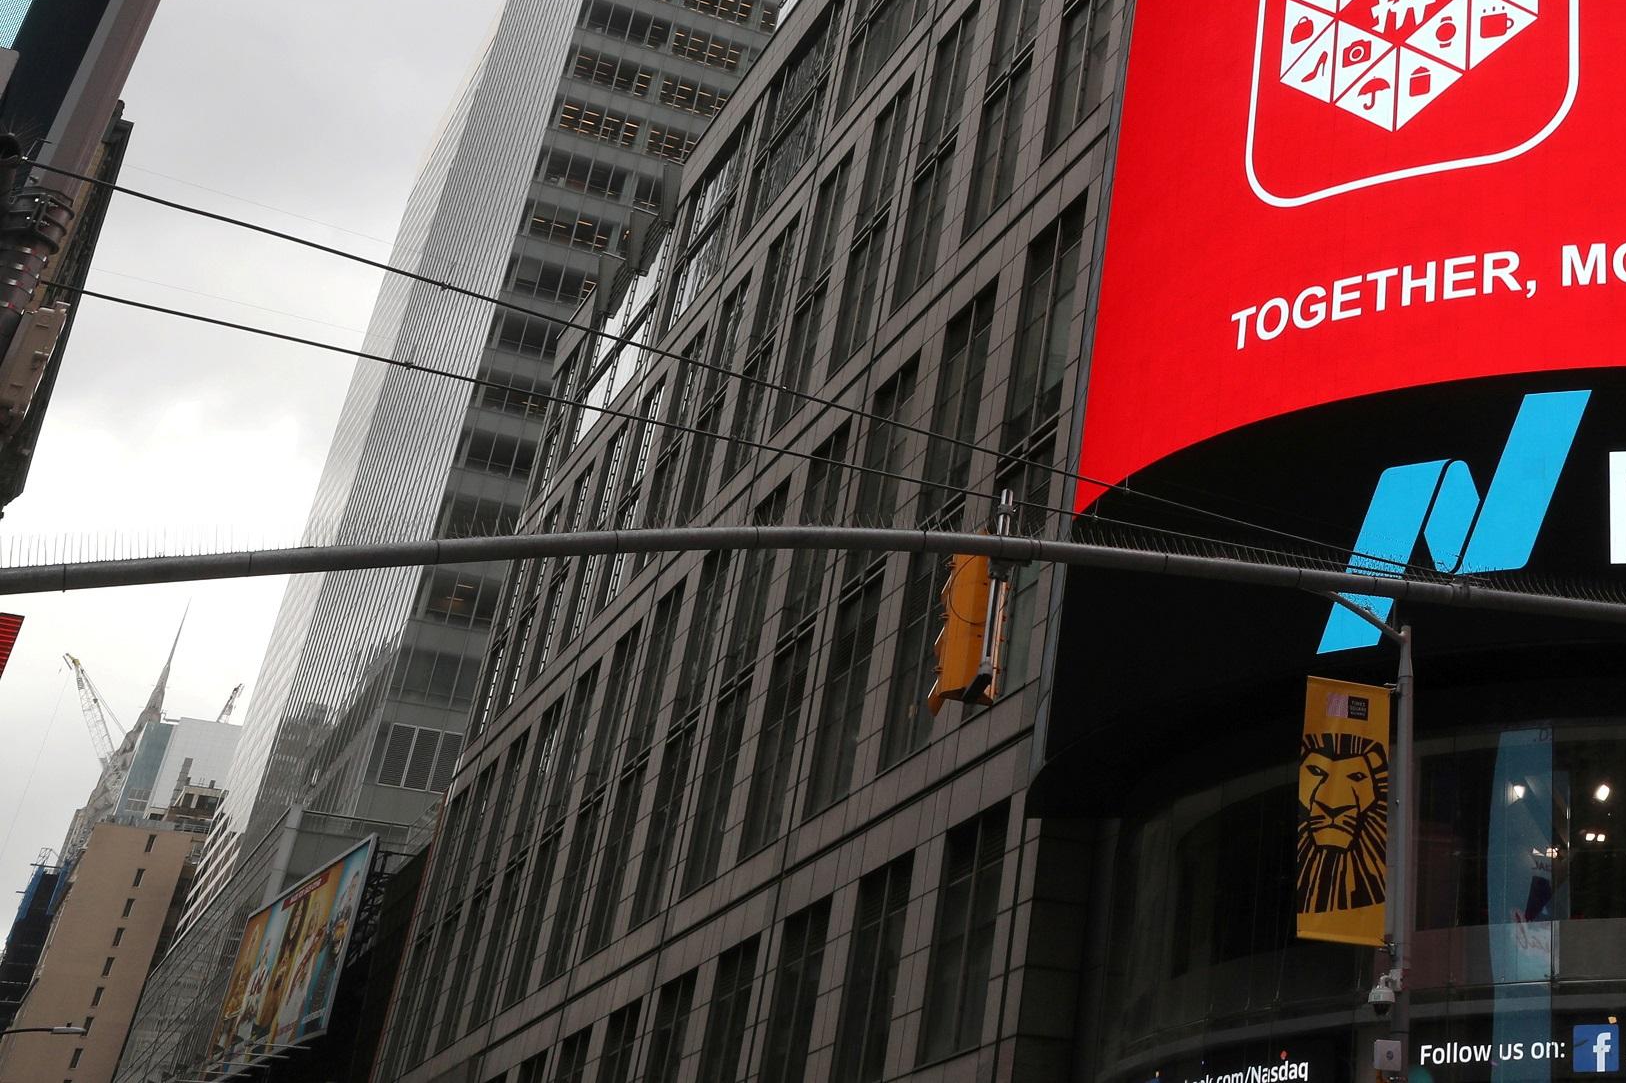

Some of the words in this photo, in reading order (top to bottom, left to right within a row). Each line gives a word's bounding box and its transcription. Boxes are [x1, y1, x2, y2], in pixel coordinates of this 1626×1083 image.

[1231, 251, 1537, 350] TOGETHER,
[1420, 1042, 1492, 1065] Follow
[1499, 1042, 1524, 1060] us
[1531, 1040, 1565, 1060] on:
